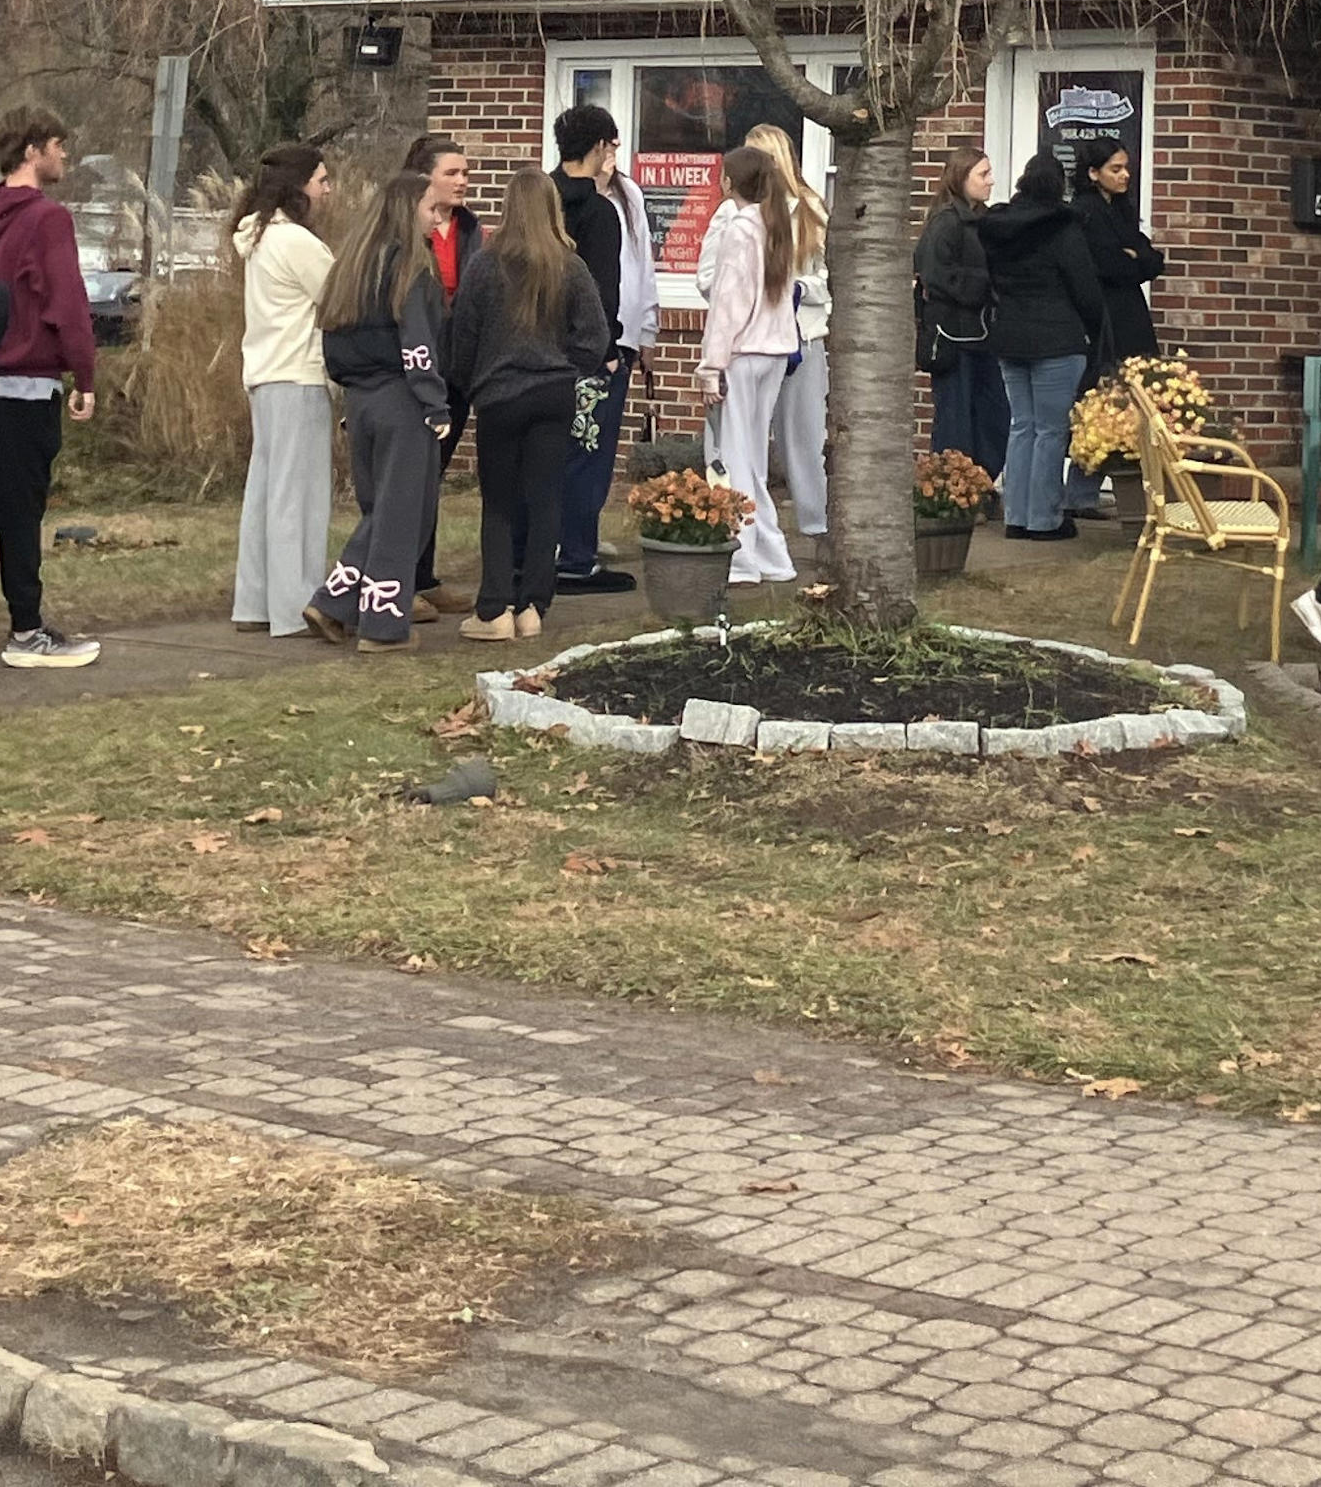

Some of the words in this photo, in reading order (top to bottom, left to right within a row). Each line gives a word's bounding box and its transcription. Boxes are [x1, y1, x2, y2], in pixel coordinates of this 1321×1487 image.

[641, 166, 657, 185] IN
[660, 167, 666, 185] 1
[670, 167, 711, 186] WEEK
